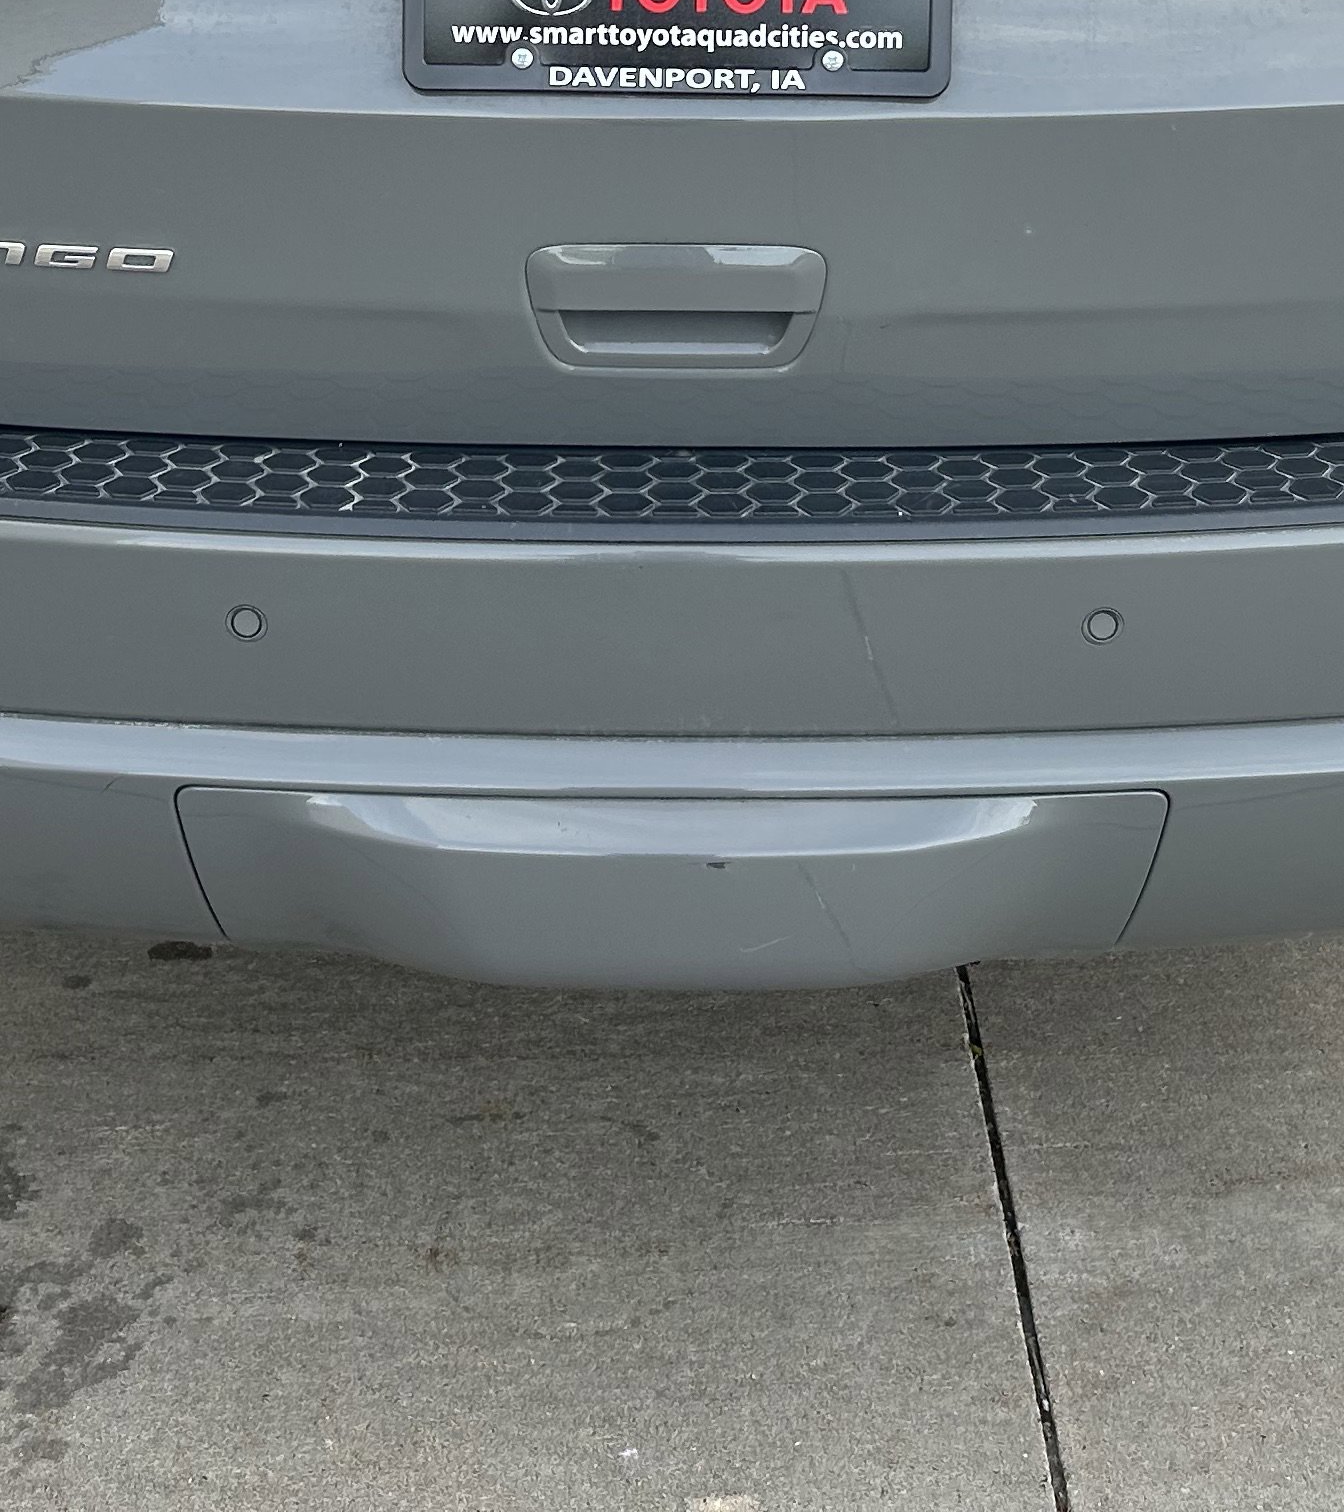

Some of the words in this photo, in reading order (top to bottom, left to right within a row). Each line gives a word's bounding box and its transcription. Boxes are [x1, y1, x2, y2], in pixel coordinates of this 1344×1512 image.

[452, 23, 904, 51] www.smarttoyotaquadcities.com
[548, 66, 760, 93] DAVENPORT,
[771, 68, 806, 90] IA
